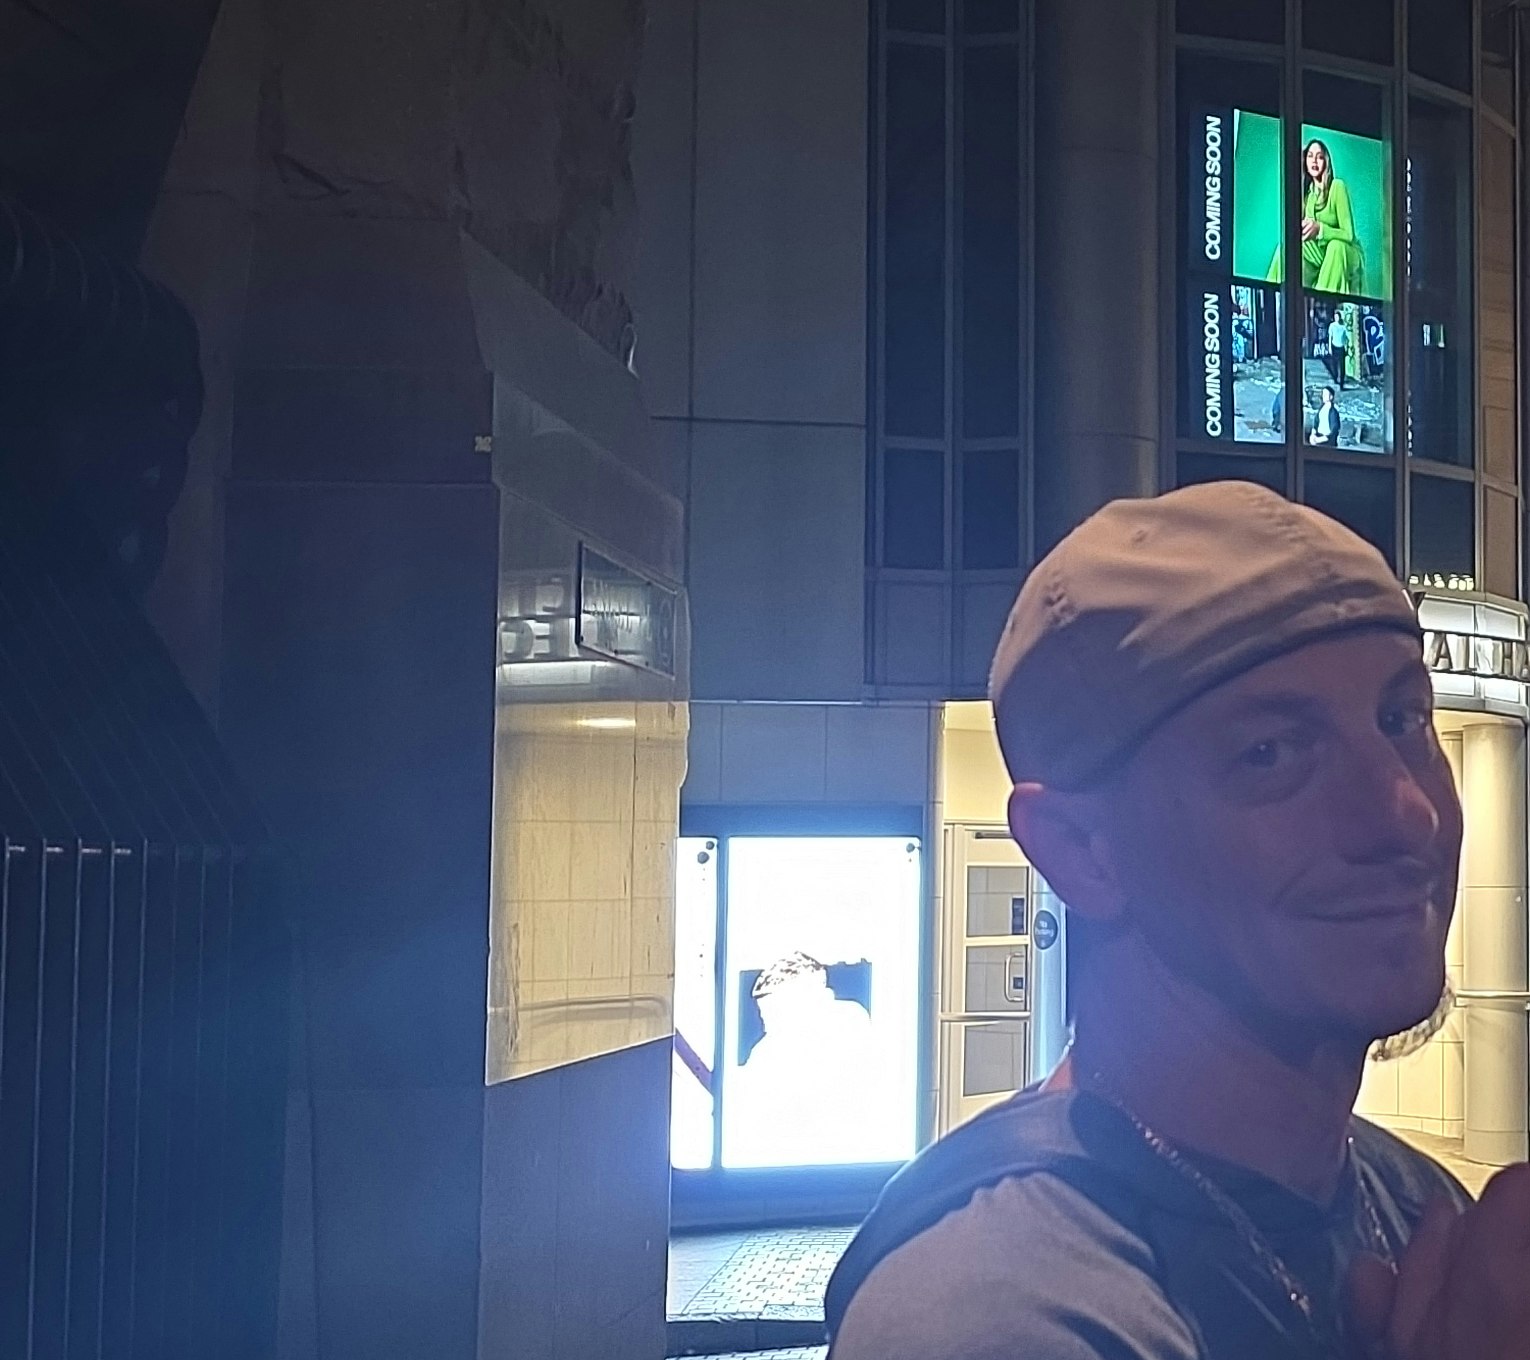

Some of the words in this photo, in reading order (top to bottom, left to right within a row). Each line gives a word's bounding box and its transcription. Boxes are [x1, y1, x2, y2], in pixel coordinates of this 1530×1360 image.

[1205, 115, 1222, 175] SOON
[1205, 176, 1221, 260] COMING
[1204, 293, 1220, 352] SOON
[1205, 353, 1222, 437] COMING
